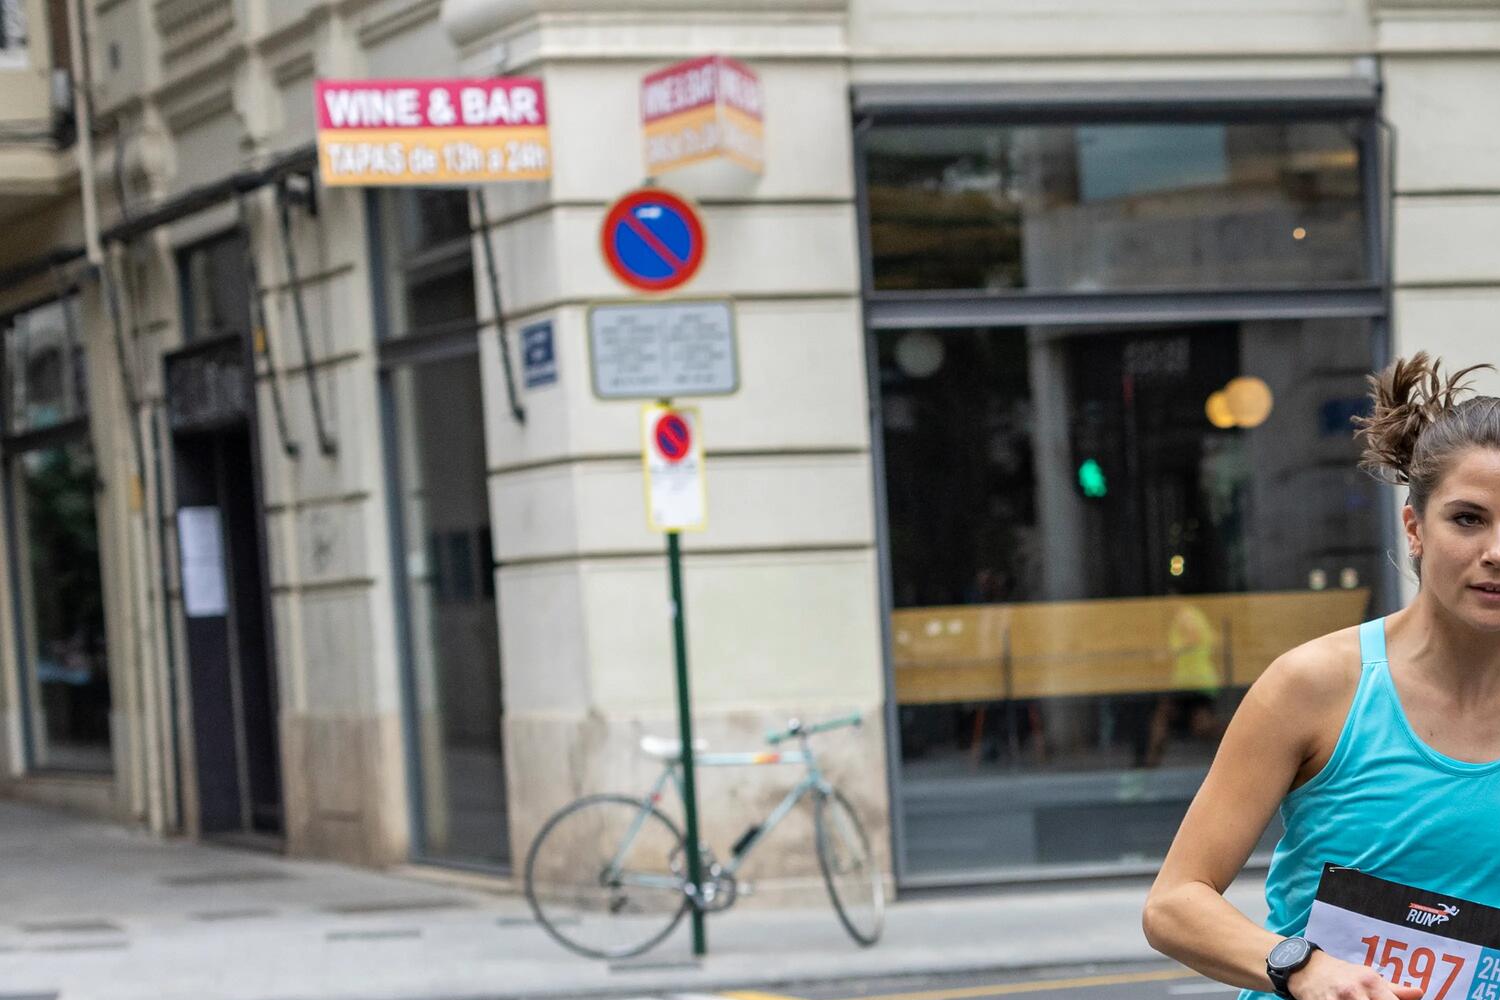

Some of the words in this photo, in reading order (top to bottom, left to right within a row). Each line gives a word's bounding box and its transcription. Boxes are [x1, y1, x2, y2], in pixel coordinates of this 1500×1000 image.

[324, 88, 422, 127] WINE
[427, 87, 456, 126] &
[460, 86, 540, 125] BAR
[327, 142, 406, 176] TAPAS
[1405, 908, 1436, 927] RUN
